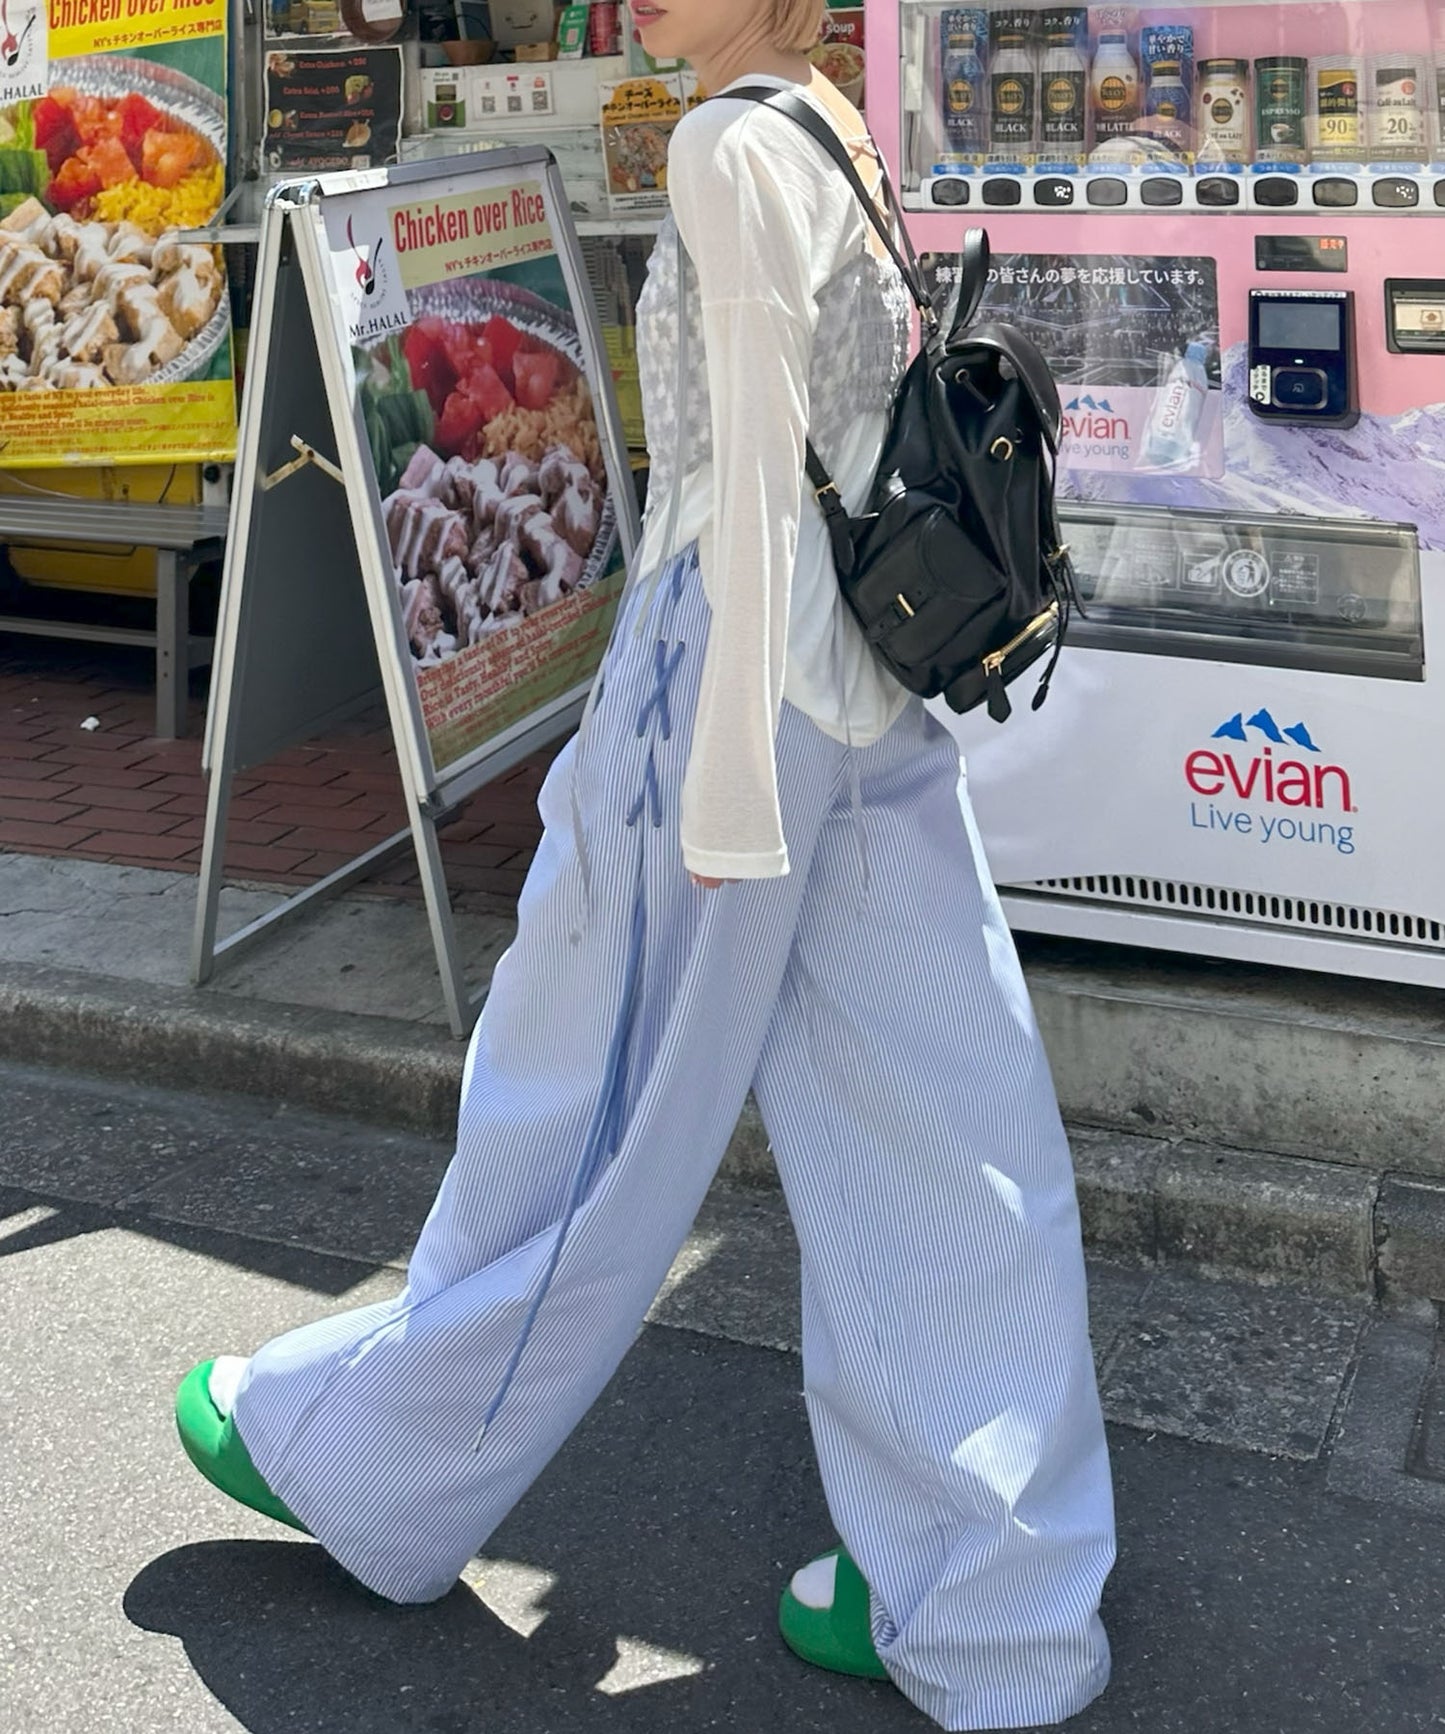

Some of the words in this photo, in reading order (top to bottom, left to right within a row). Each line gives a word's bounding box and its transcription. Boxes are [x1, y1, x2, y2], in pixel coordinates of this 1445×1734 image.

[825, 22, 855, 34] soup
[995, 123, 1026, 133] BLACK
[1045, 122, 1078, 132] BLACK
[1326, 119, 1348, 135] 90
[1387, 117, 1408, 135] 20
[393, 204, 470, 254] Chicken
[473, 199, 508, 238] over
[510, 187, 546, 229] Rice
[935, 266, 1205, 286] 練習の皆さんの夢を応援しています。
[349, 311, 408, 338] Mr.HALAL
[1084, 444, 1130, 461] young
[1184, 746, 1352, 813] evian
[1191, 802, 1252, 834] Live
[1259, 815, 1355, 855] young
